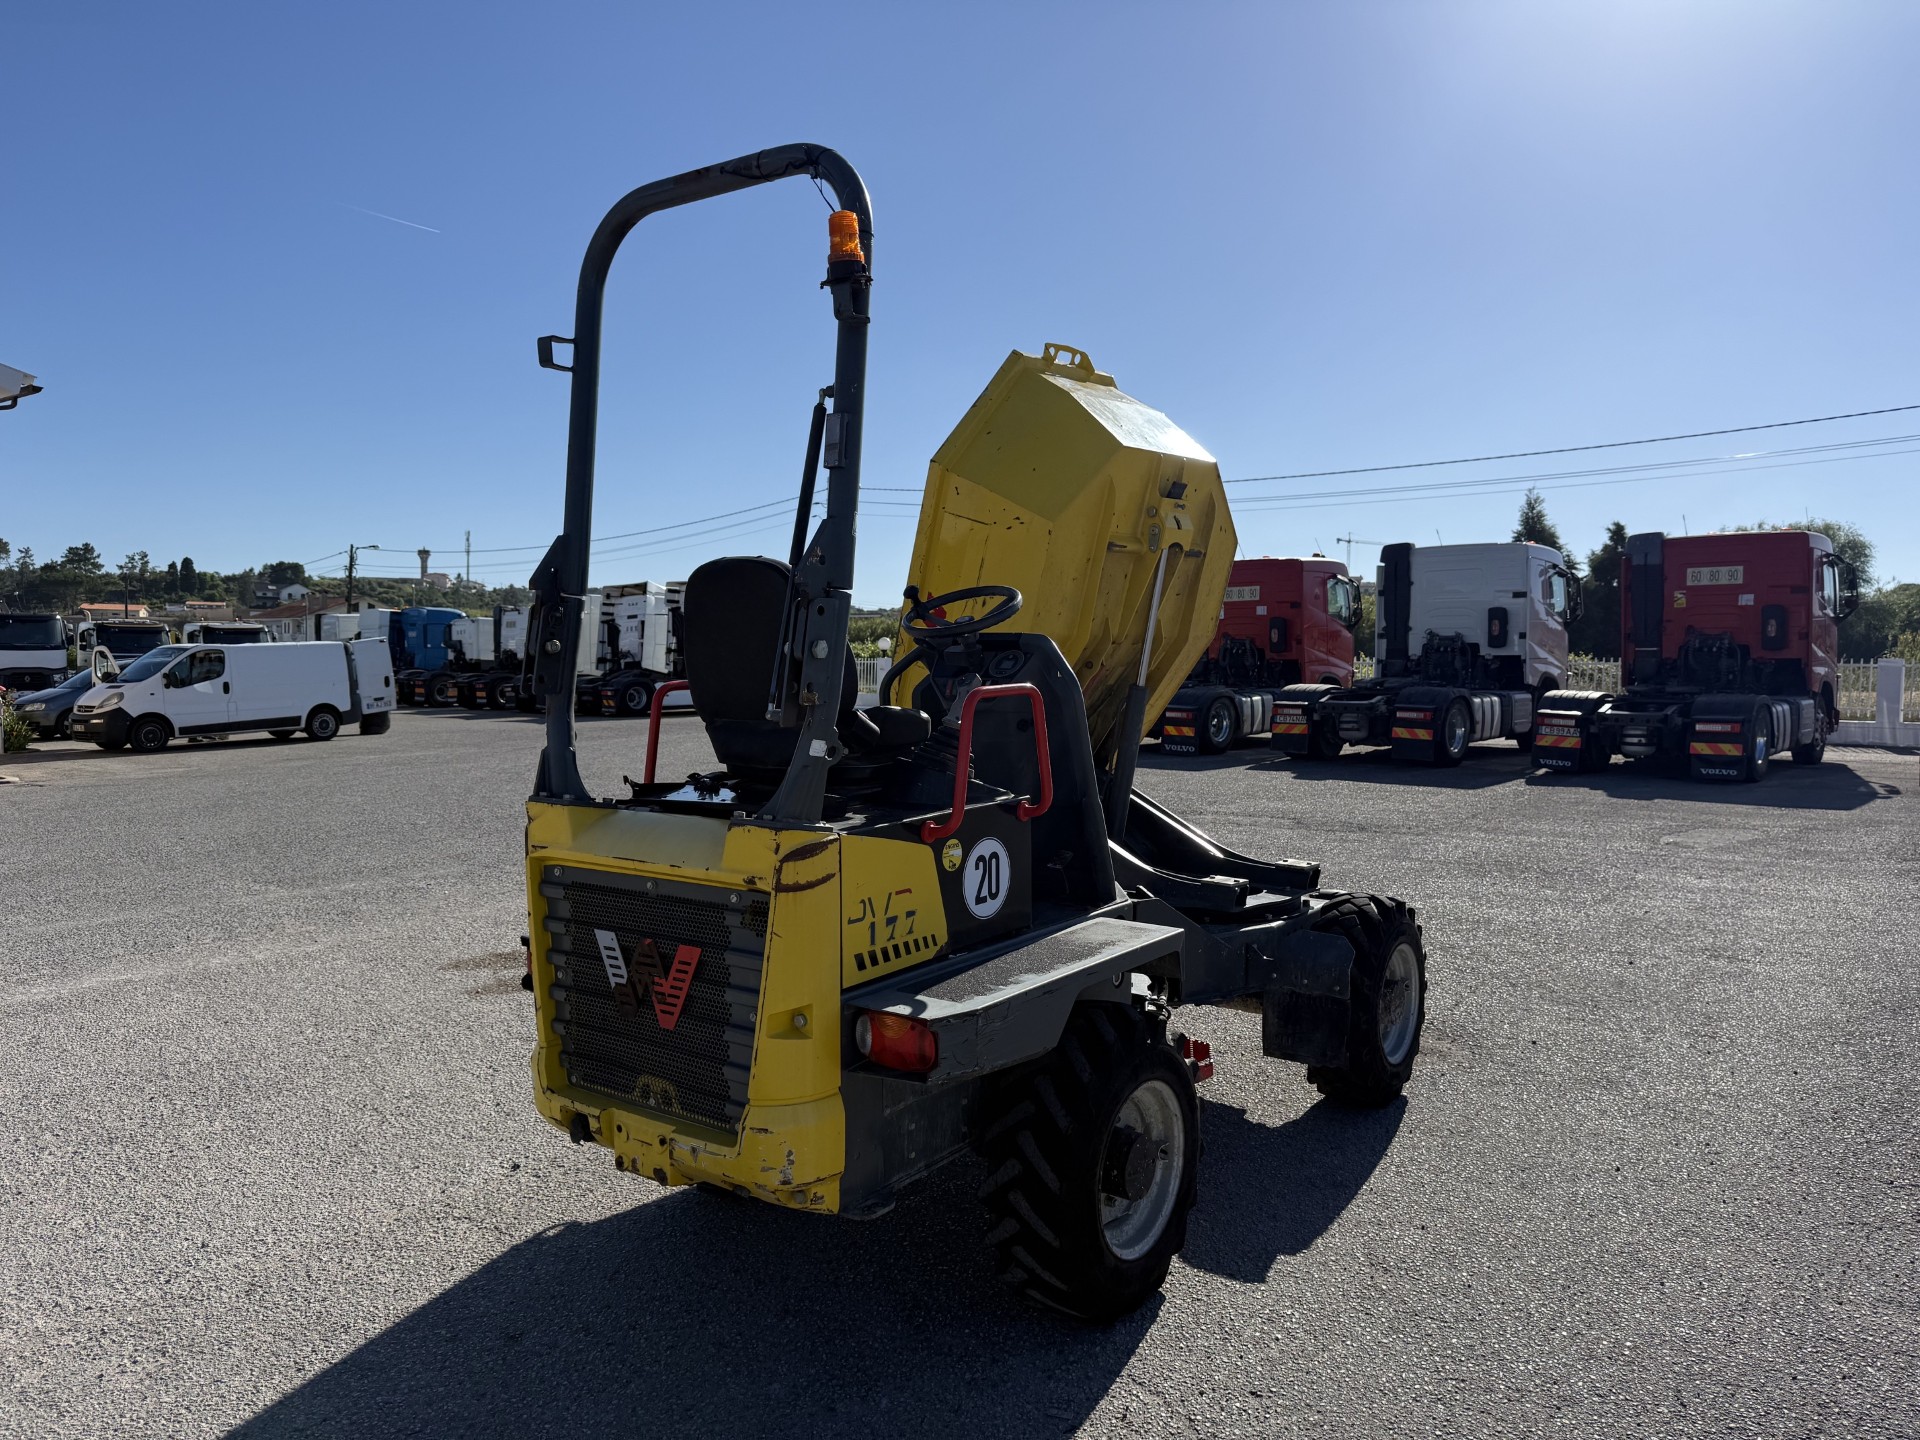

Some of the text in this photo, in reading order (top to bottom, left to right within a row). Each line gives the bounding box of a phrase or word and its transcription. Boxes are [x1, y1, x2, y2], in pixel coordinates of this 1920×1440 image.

[1690, 569, 1739, 583] 60 80 90
[1164, 743, 1195, 752] VOLVO
[1539, 758, 1571, 767] VOLVO
[1700, 768, 1737, 776] VOLVO
[974, 851, 1000, 906] 20
